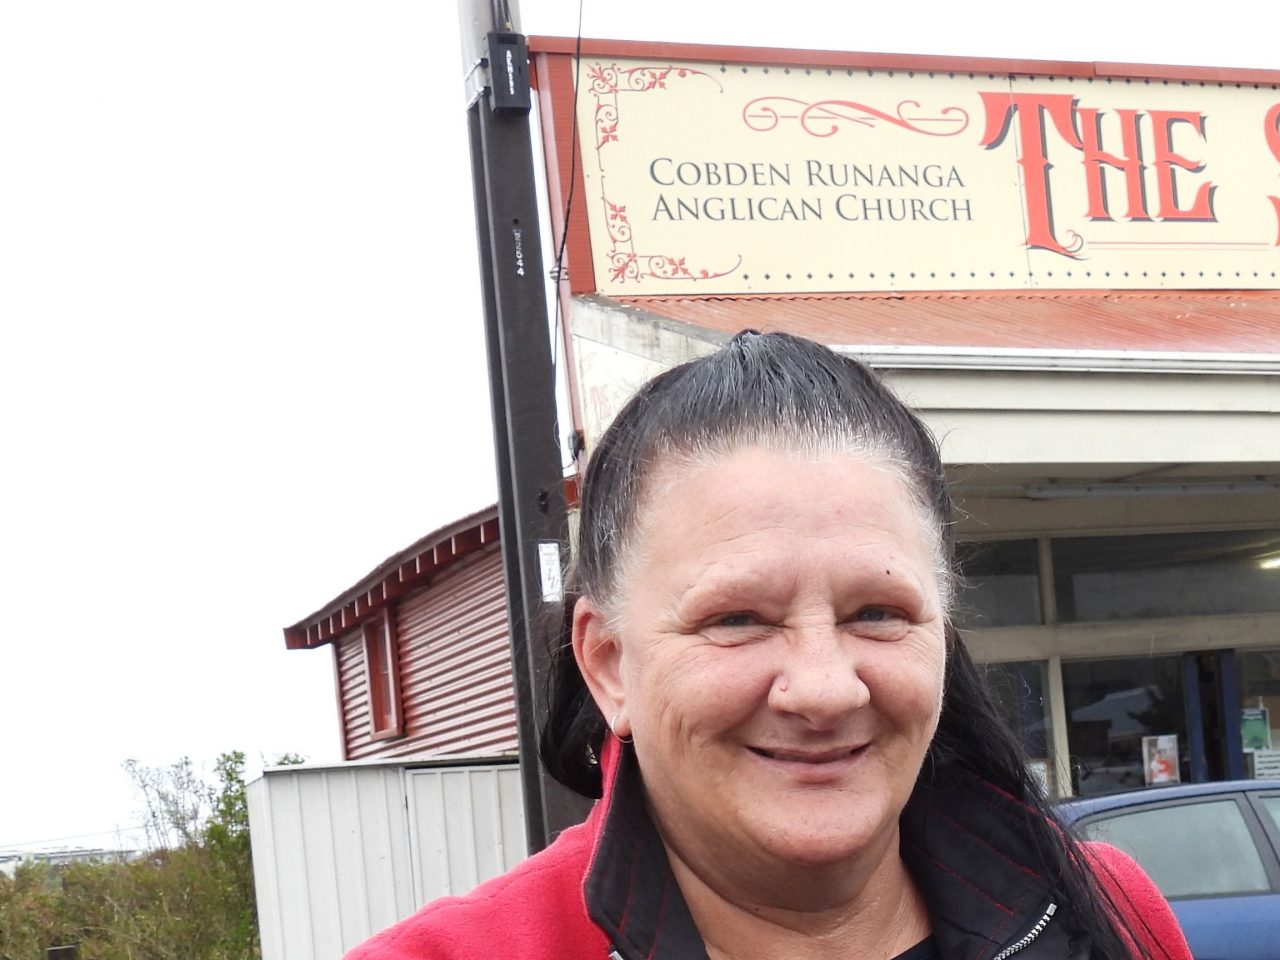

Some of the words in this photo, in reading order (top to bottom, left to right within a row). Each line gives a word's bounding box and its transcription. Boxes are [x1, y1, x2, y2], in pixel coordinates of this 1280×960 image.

[649, 157, 791, 187] COBDEN
[806, 159, 966, 188] RUNANGA
[979, 91, 1218, 260] THE
[652, 193, 822, 221] ANGLICAN
[835, 193, 973, 221] CHURCH
